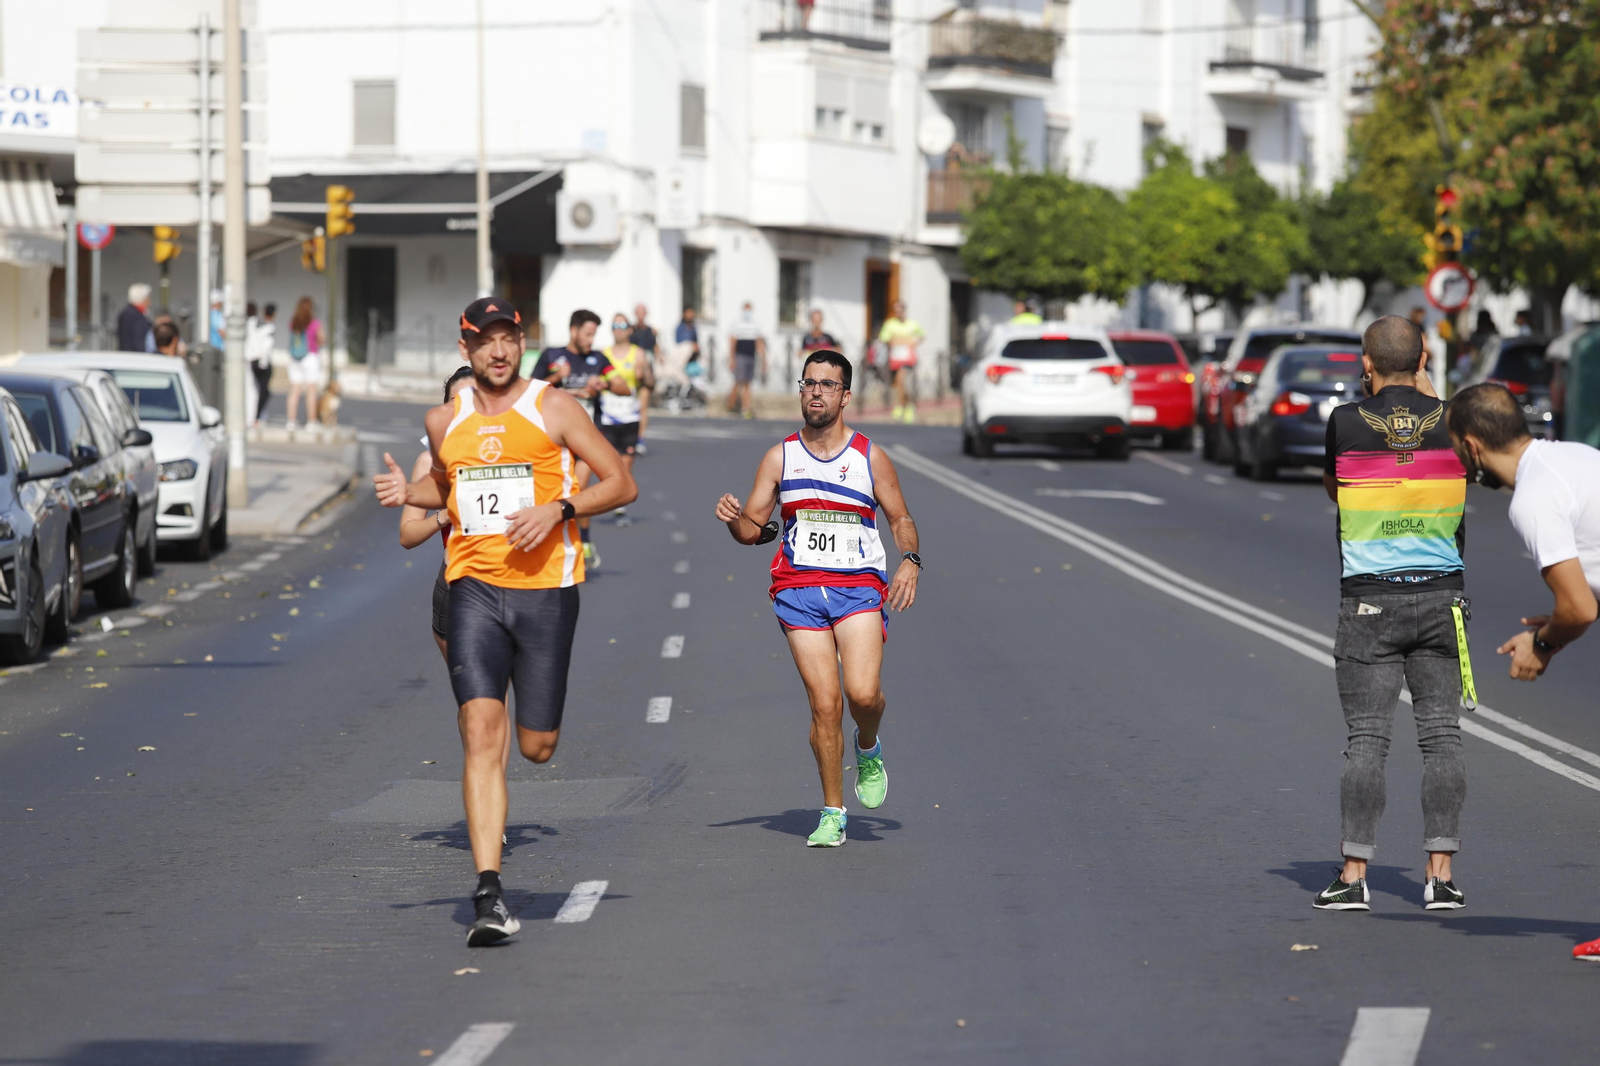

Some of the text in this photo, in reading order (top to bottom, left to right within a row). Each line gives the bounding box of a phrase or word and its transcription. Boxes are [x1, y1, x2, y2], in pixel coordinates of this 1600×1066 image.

[470, 468, 494, 480] VUELTA
[494, 468, 501, 479] A
[500, 466, 528, 478] HUELVA
[476, 494, 499, 515] 12
[801, 511, 857, 524] 34 VUELTA A HUELVA
[807, 532, 836, 552] 501
